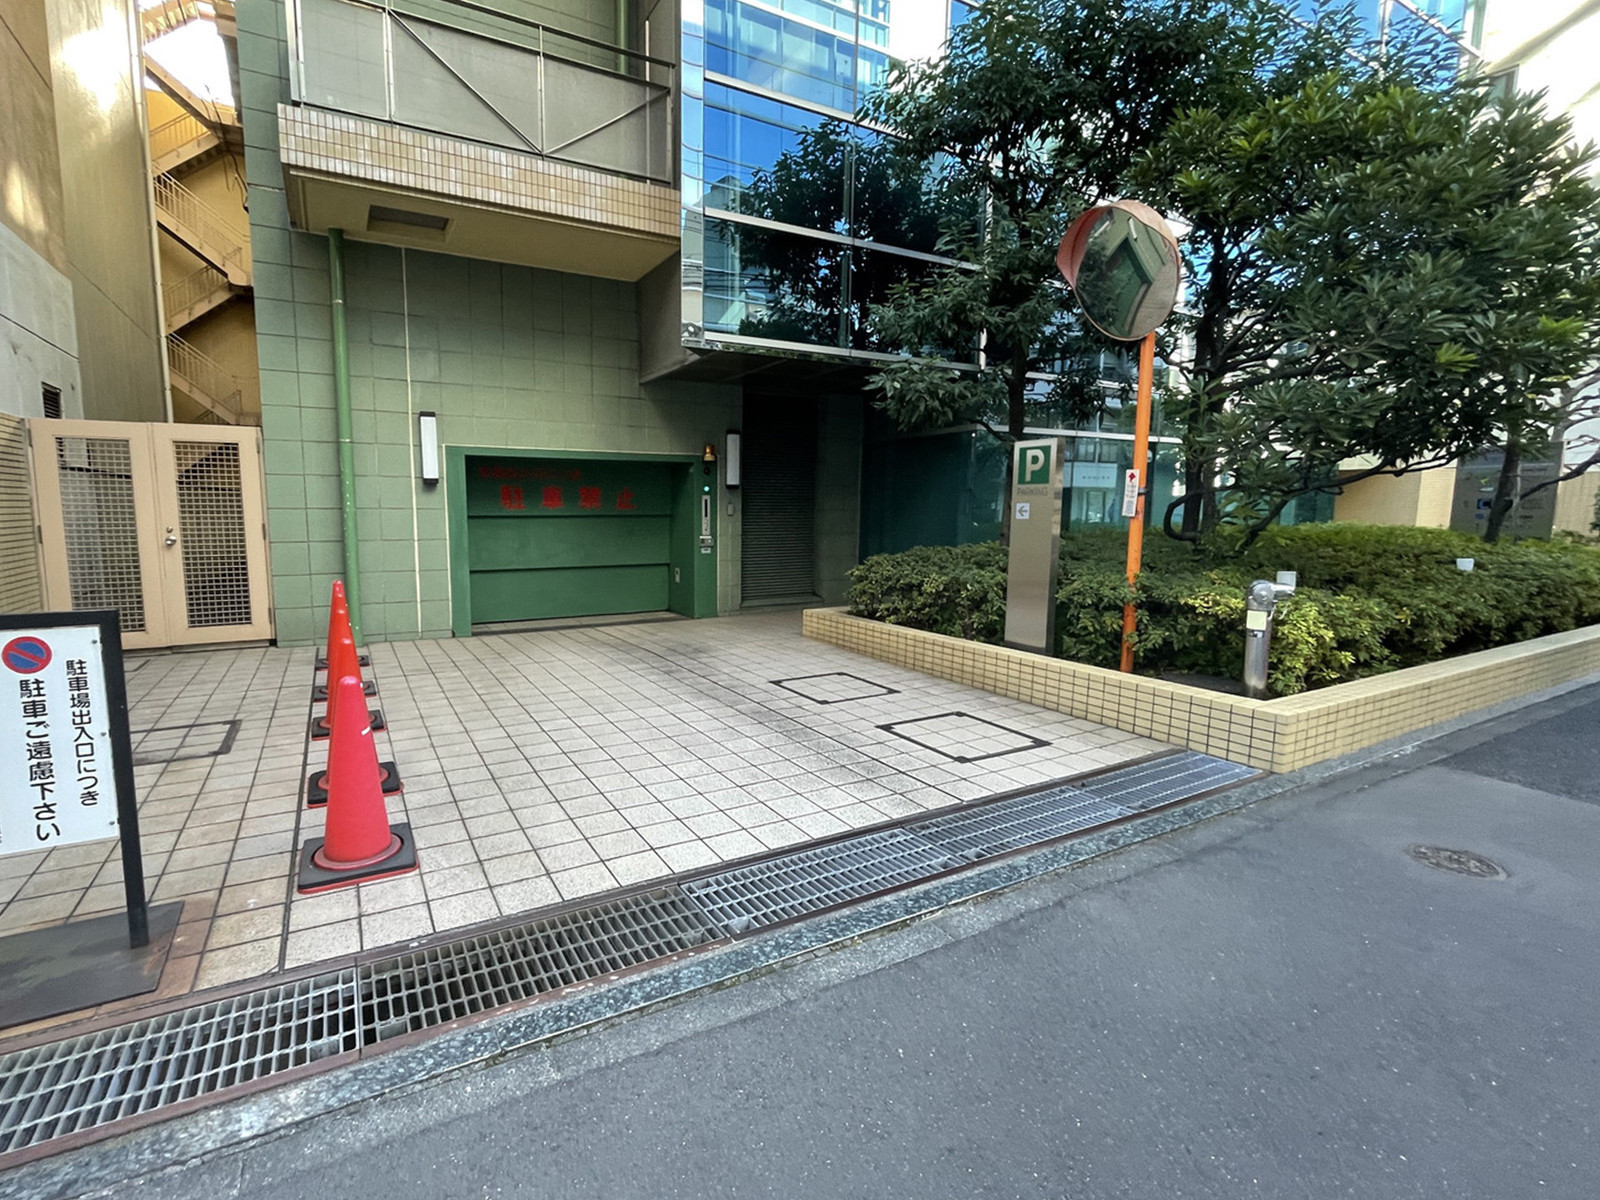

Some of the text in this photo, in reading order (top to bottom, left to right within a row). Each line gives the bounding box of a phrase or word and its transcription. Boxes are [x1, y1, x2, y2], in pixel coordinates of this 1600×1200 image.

[1016, 486, 1049, 497] PARKING
[1025, 448, 1045, 482] P
[19, 678, 61, 842] 駐車ご遠慮下さい
[66, 658, 100, 807] 駐車場出入口につき
